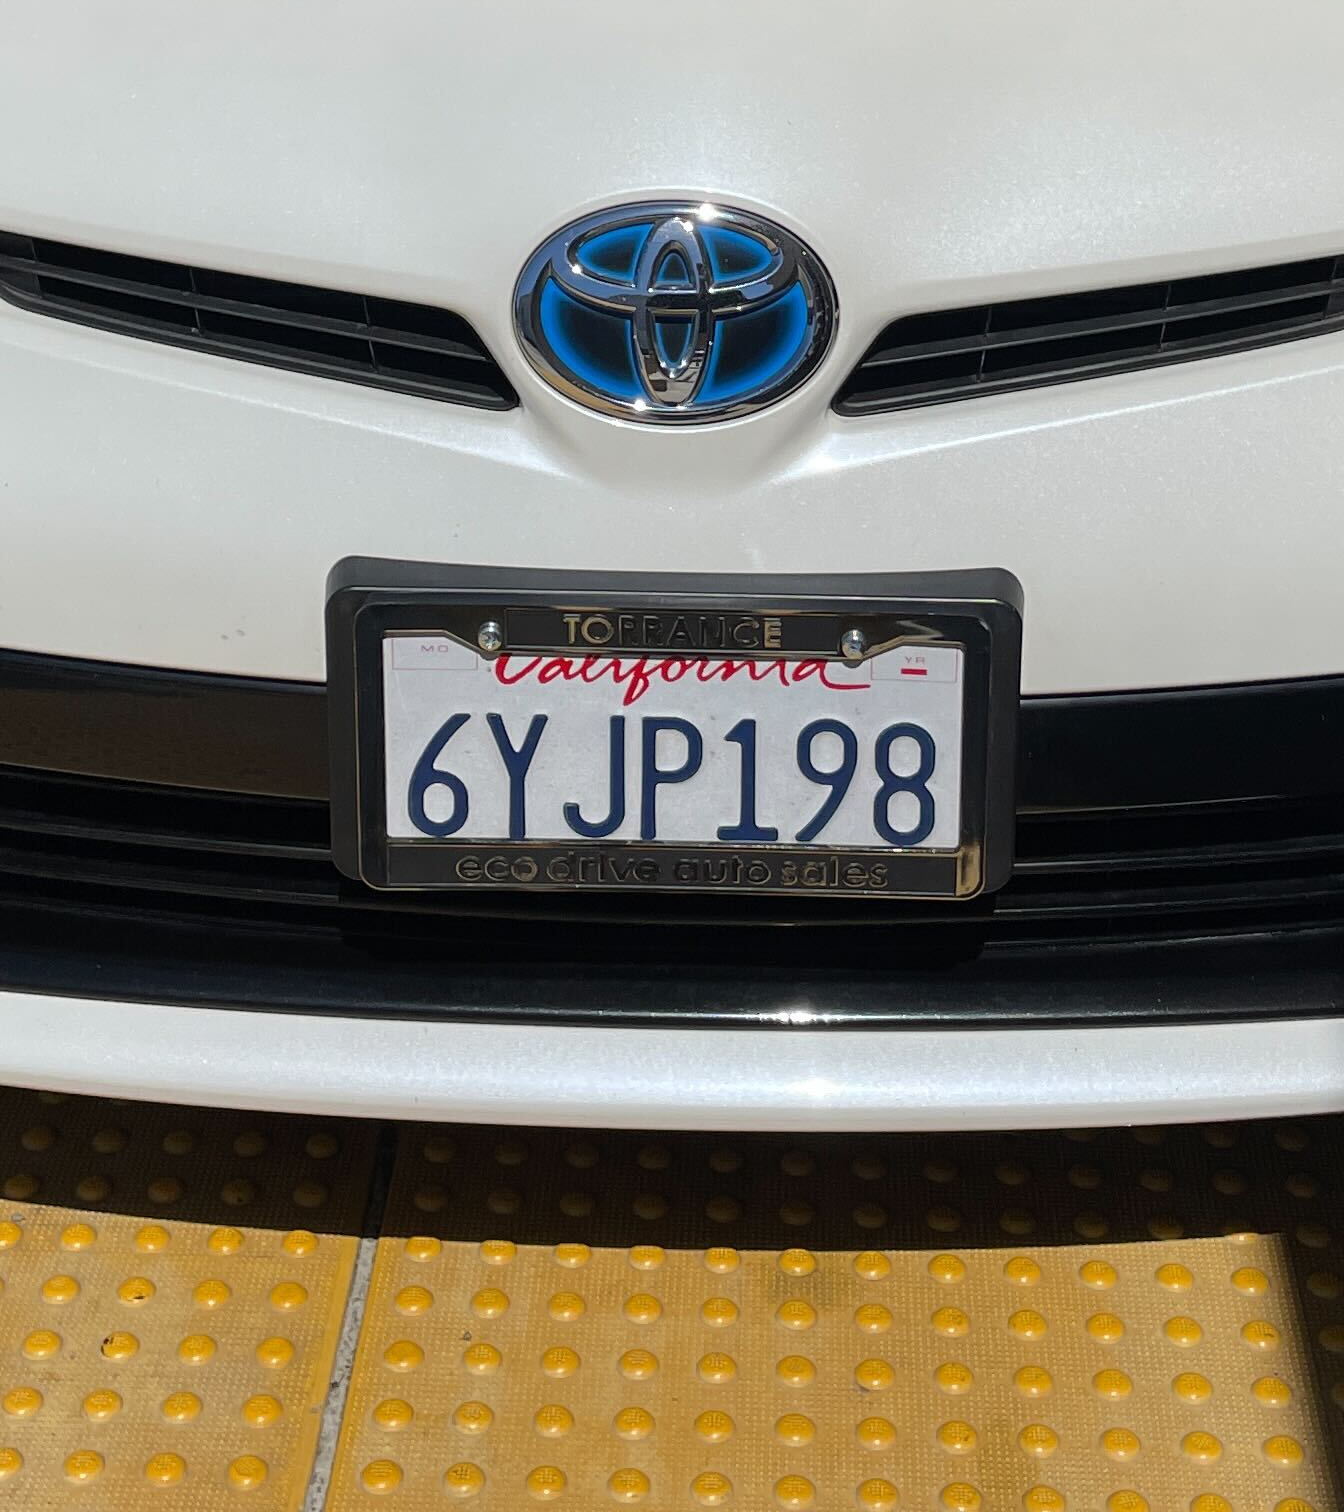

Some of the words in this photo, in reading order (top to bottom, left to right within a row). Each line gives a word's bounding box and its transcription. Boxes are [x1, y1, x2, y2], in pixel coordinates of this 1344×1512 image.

[420, 644, 449, 654] MO
[562, 612, 783, 649] TORRANCE
[903, 655, 926, 664] YR
[406, 711, 937, 847] 6YJP198
[672, 853, 772, 887] auto
[779, 850, 889, 889] sales
